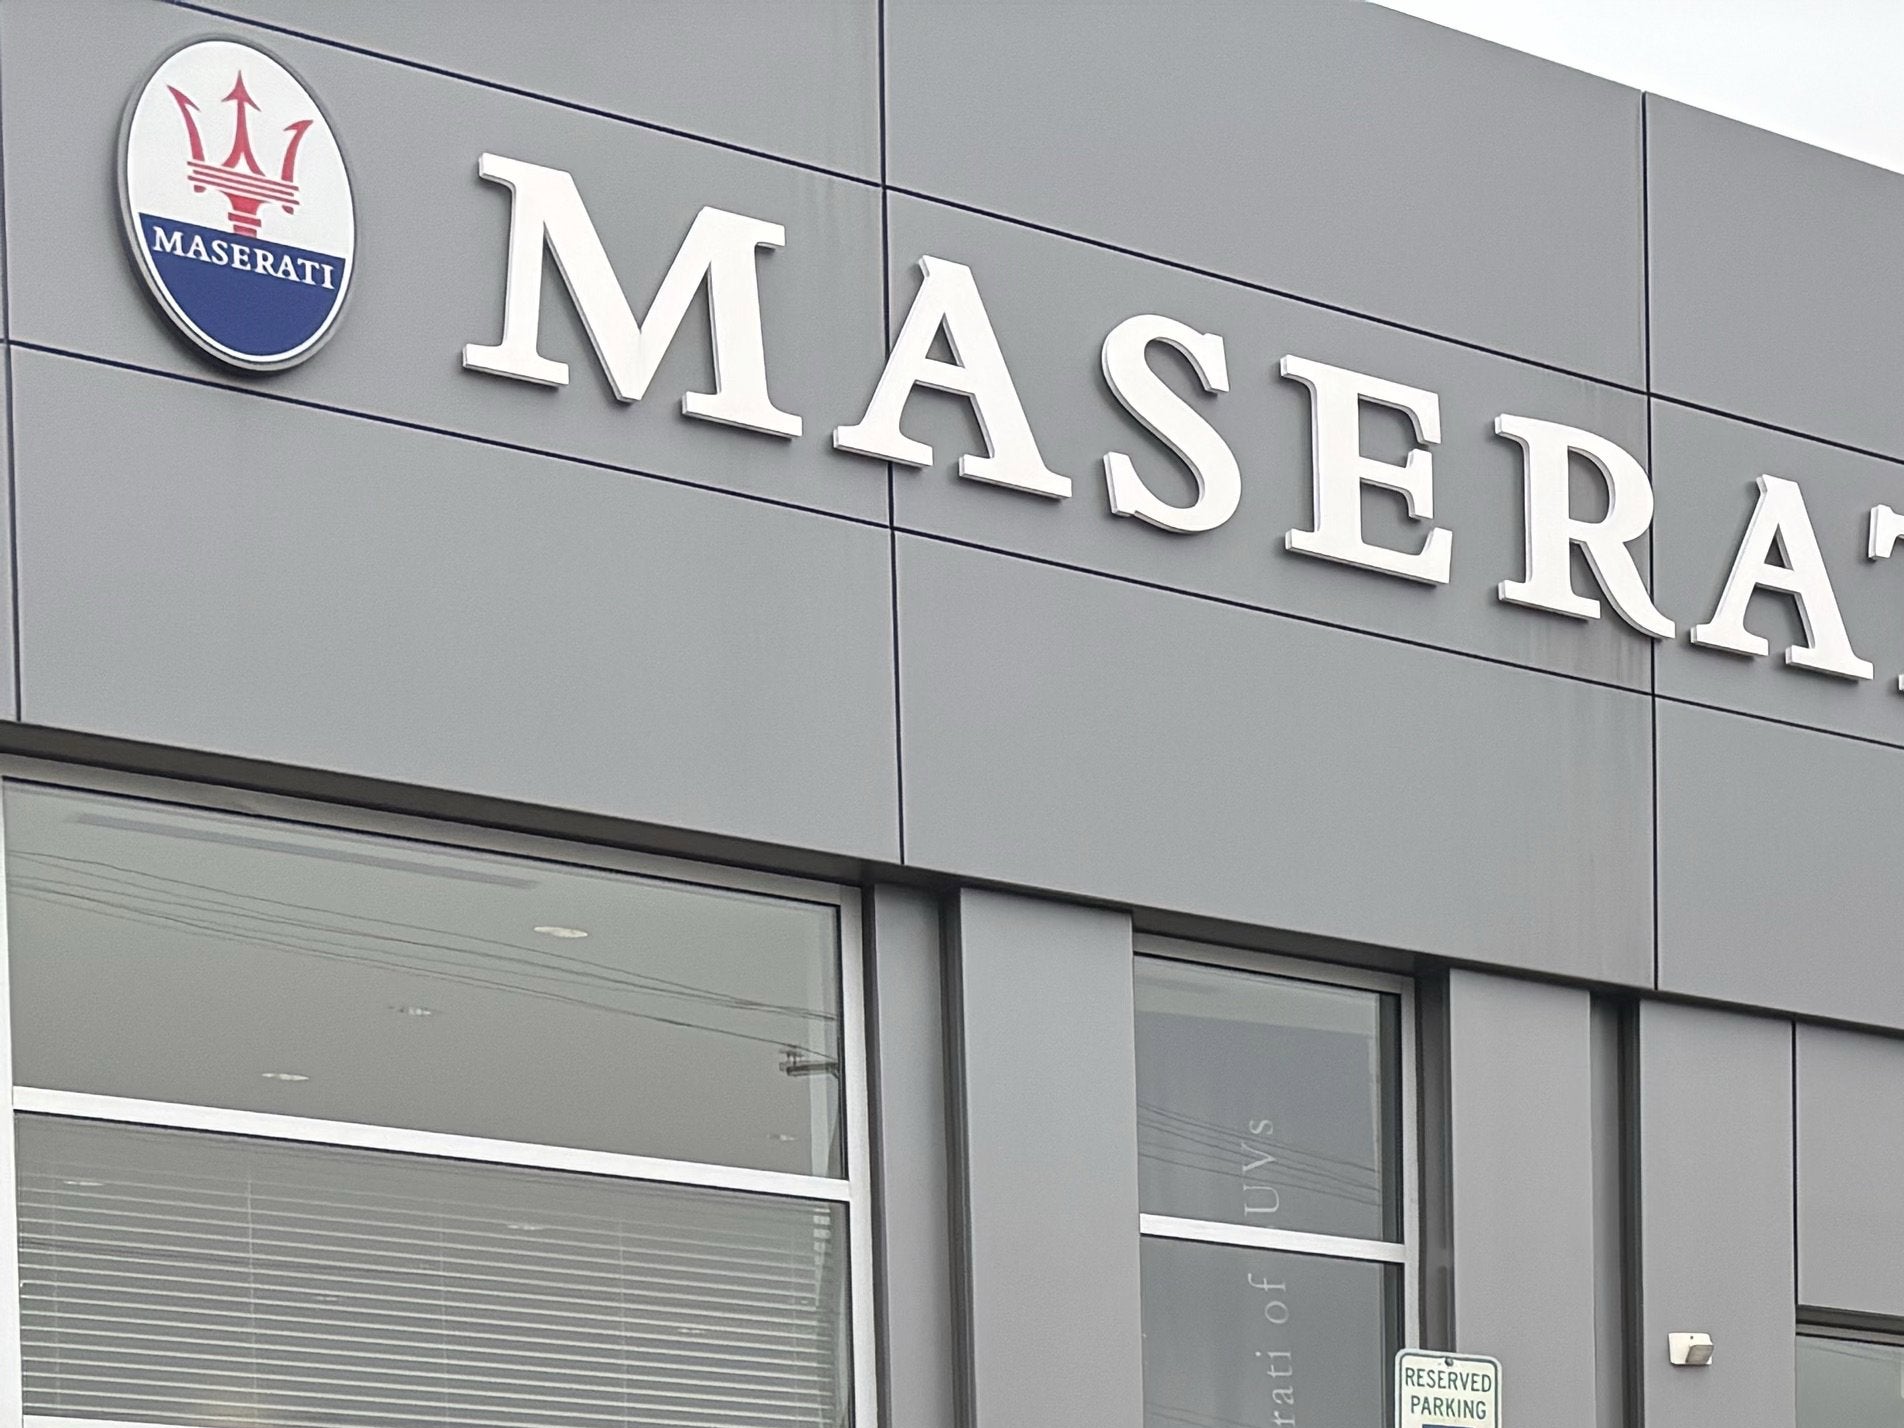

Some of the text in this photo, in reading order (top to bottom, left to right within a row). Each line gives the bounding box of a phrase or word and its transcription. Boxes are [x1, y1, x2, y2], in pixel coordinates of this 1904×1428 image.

[152, 226, 335, 290] MASERATI
[1241, 1118, 1280, 1228] UVs
[1248, 1273, 1289, 1324] of
[1405, 1367, 1492, 1393] RESERVED
[1410, 1395, 1486, 1420] PARKING
